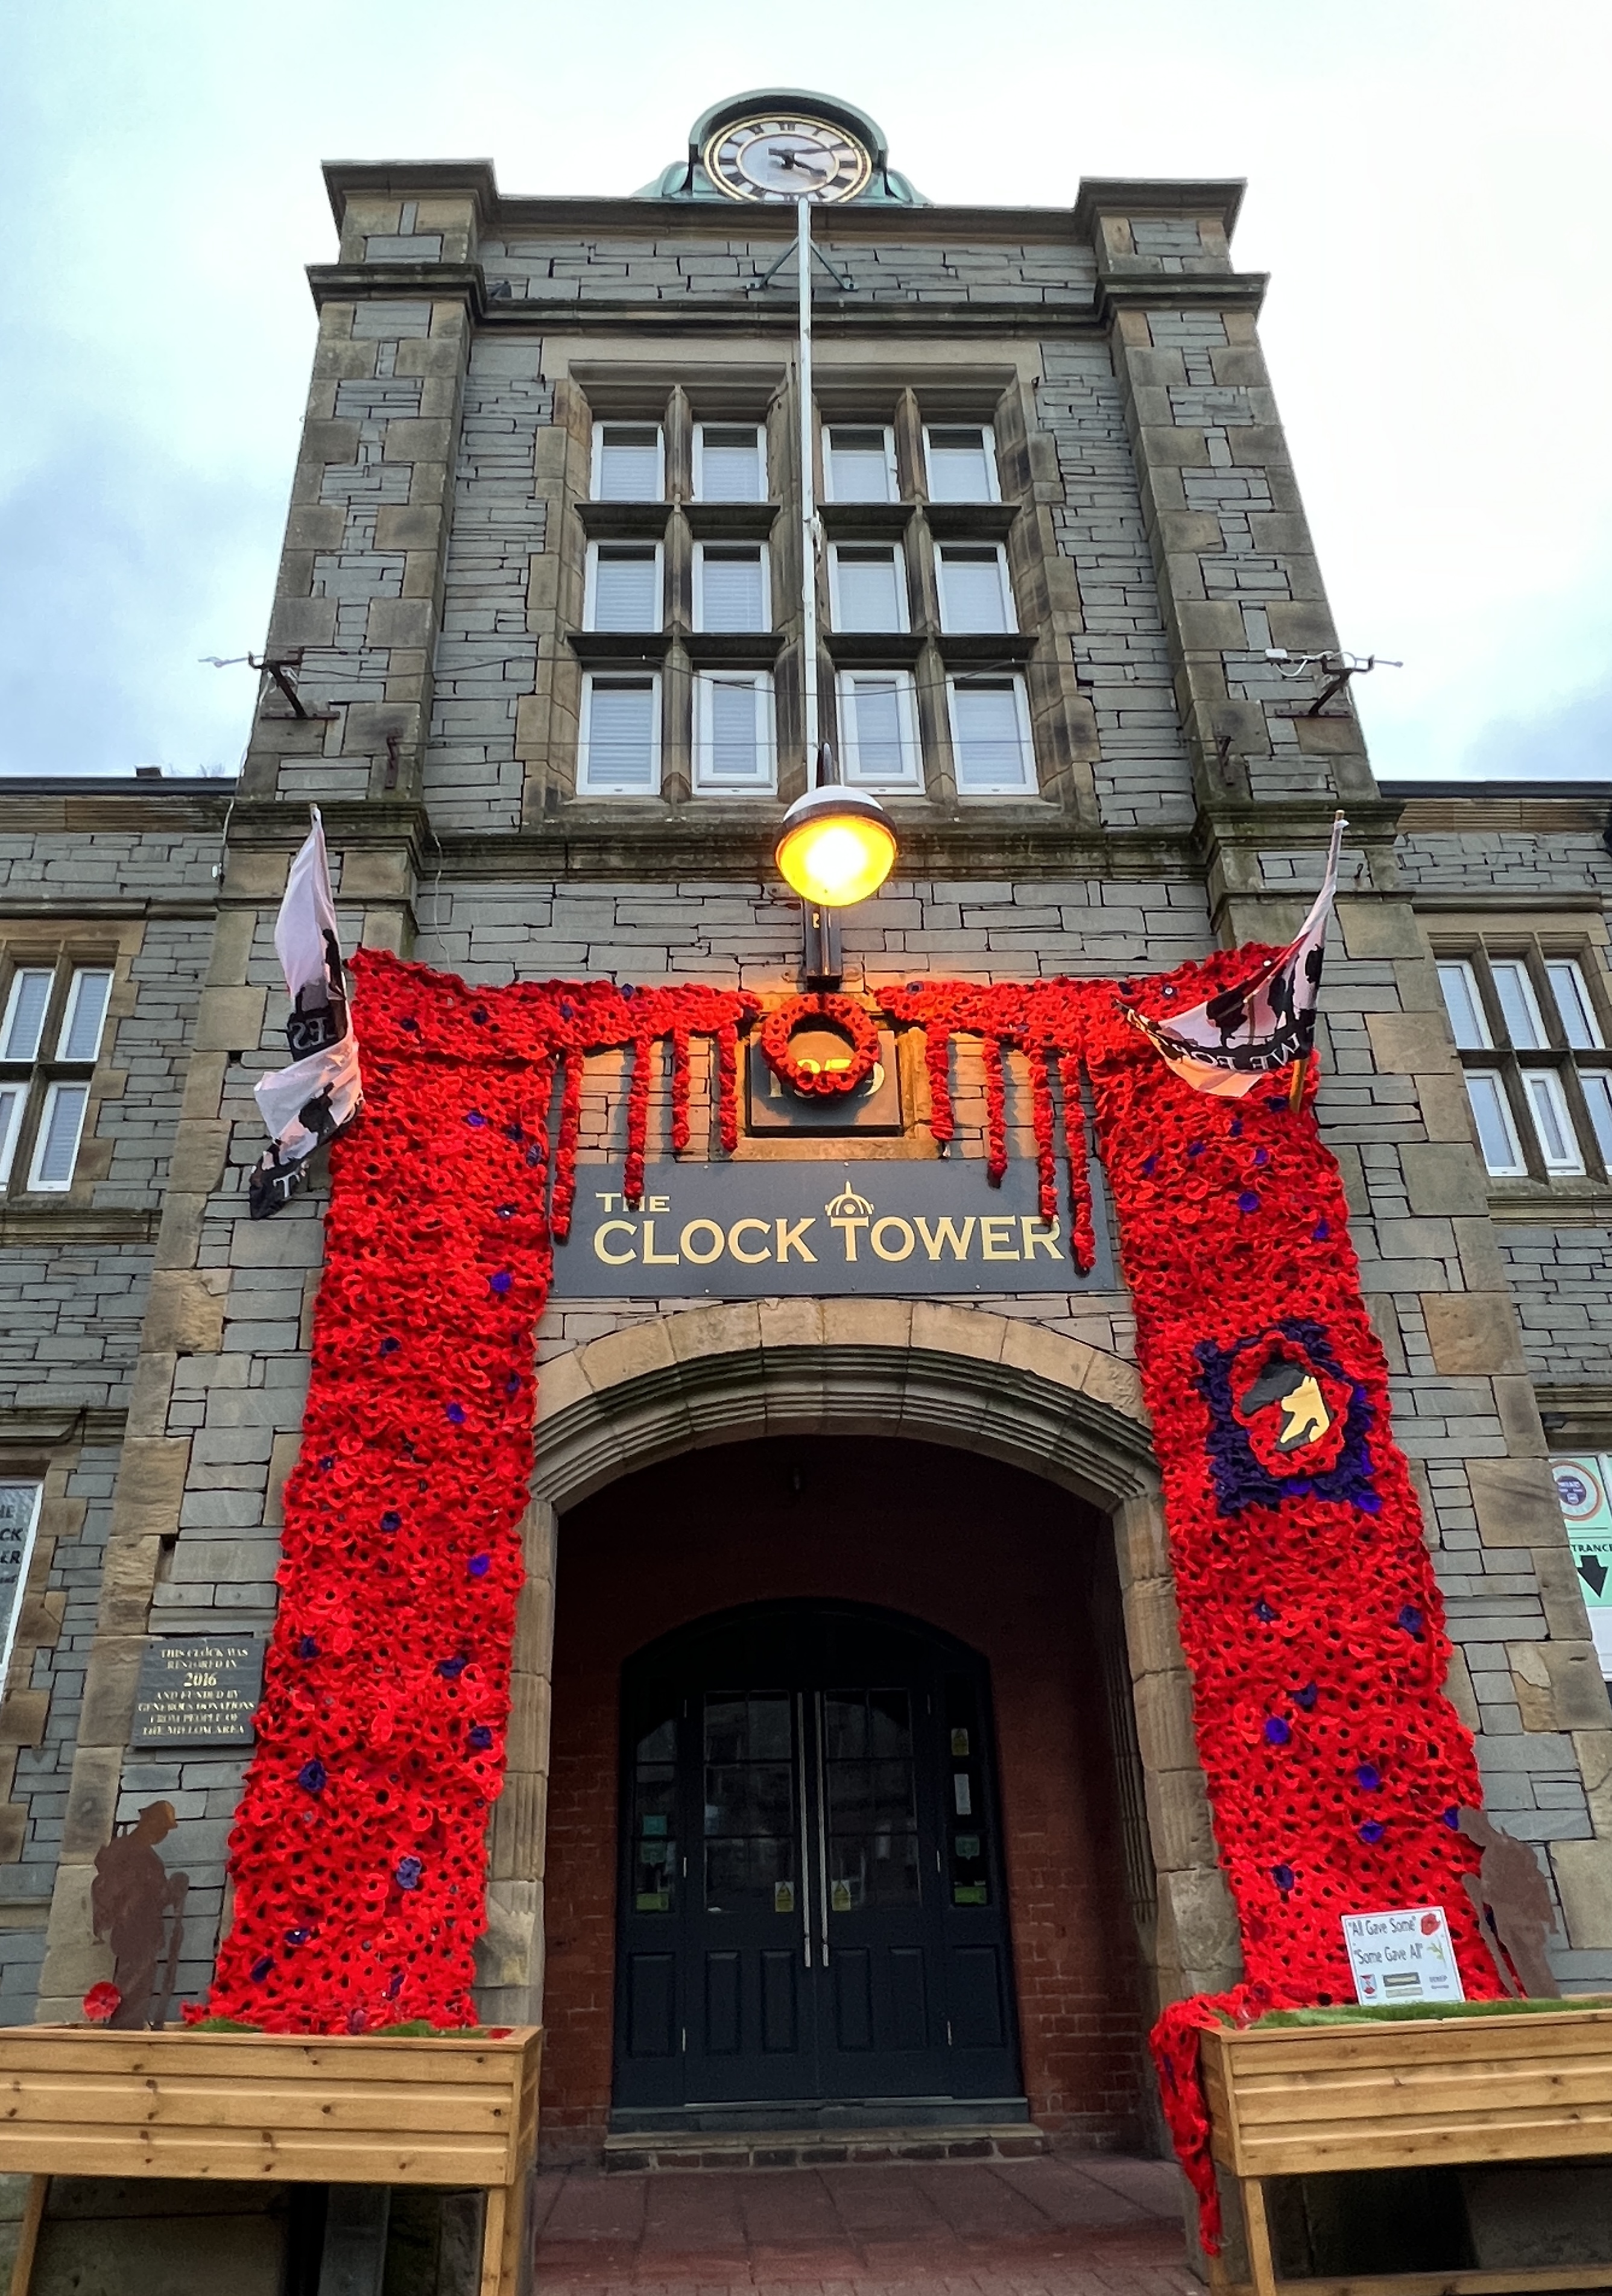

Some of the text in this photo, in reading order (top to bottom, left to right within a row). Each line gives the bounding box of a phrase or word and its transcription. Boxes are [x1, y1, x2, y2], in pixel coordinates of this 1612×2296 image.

[593, 1214, 1065, 1265] CLOCK TOWER
[183, 1673, 218, 1687] 2016
[1365, 1920, 1388, 1935] Gave
[1384, 1946, 1407, 1961] Gave
